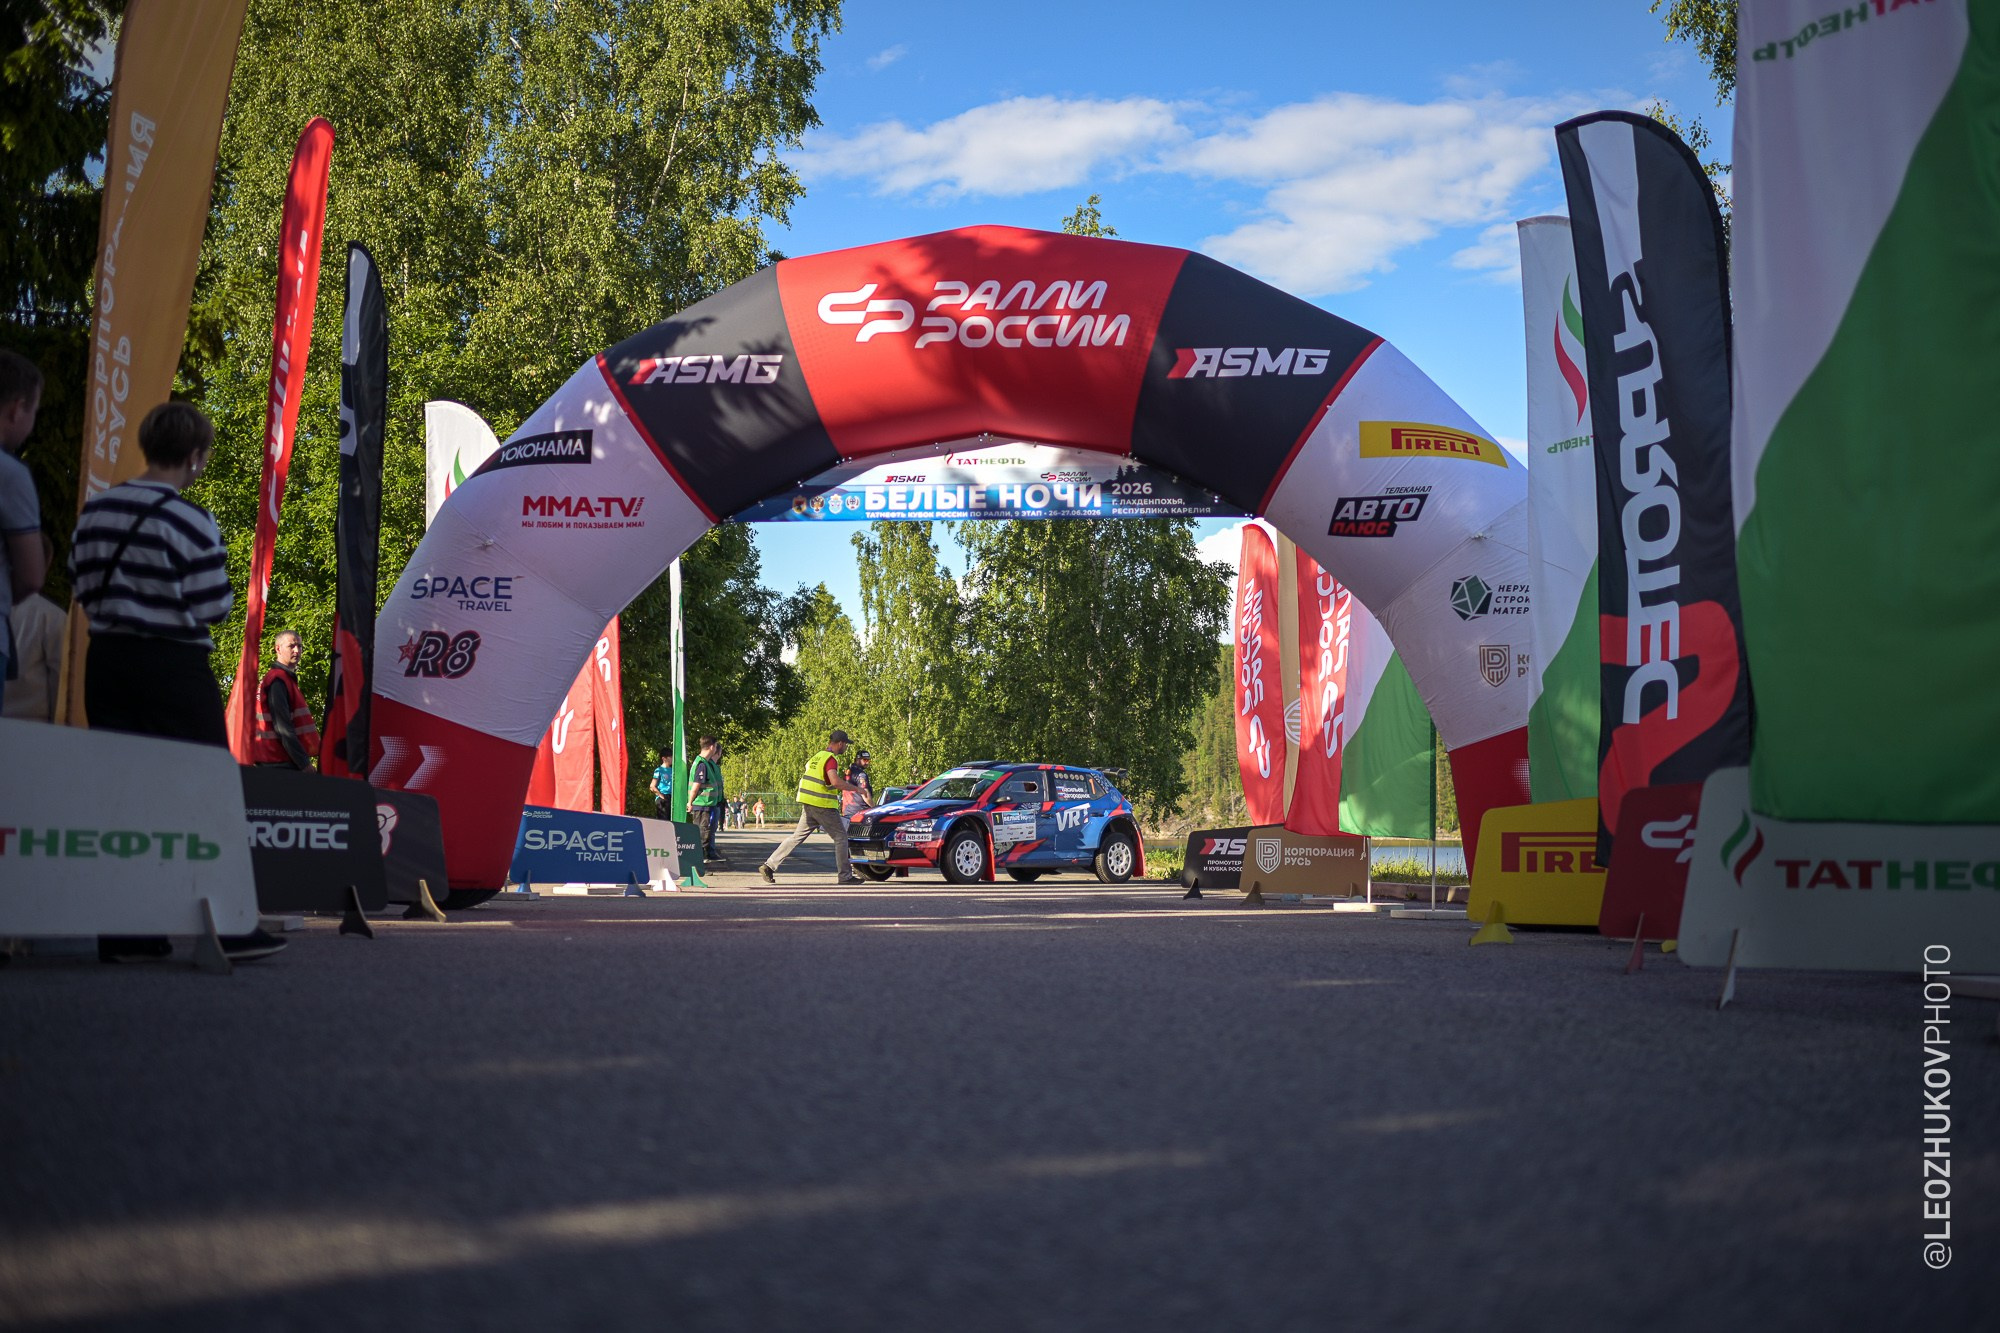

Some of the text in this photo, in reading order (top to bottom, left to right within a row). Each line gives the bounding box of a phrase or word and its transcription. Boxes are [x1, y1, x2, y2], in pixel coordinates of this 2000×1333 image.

[926, 280, 1108, 311] РАЛЛИ
[914, 314, 1130, 349] РОССИИ
[644, 354, 783, 384] ASMG
[1184, 347, 1331, 379] ASMG
[1390, 428, 1481, 456] PIRELLI
[500, 438, 585, 463] YOKOHAMA
[956, 457, 1026, 466] ТАТНЕФТЬ
[890, 475, 926, 483] ASMG
[1111, 482, 1153, 495] 2026
[1385, 485, 1432, 495] ТЕЛЕКАНАЛ
[865, 483, 1102, 511] БЕЛЫЕ НОЧИ
[1119, 498, 1186, 506] ЛАХДЕНПОХЬЯ,
[865, 511, 907, 519] ТАТНЕФТЬ
[907, 511, 935, 519] КУБОК
[935, 511, 968, 519] РОССИИ
[983, 510, 1013, 518] РАЛЛИ,
[1021, 509, 1042, 517] ЭТАП
[1111, 506, 1211, 515] РЕСПУБЛИКА КАРЕЛИЯ
[1335, 497, 1421, 521] АВТО
[521, 520, 534, 528] МЫ
[536, 521, 564, 529] ЛЮБИМ
[573, 521, 624, 529] ПОКАЗЫВАЕМ
[1331, 521, 1391, 535] ПЛЮС
[410, 576, 513, 600] SPACE
[457, 600, 512, 612] TRAVEL
[403, 630, 482, 679] R8
[304, 810, 350, 819] ТЕХНОЛОГИИ
[524, 829, 625, 851] SPACE
[575, 851, 624, 862] TRAVEL
[1284, 847, 1355, 858] КОРПОРАЦИЯ
[1284, 857, 1312, 867] РУСЬ
